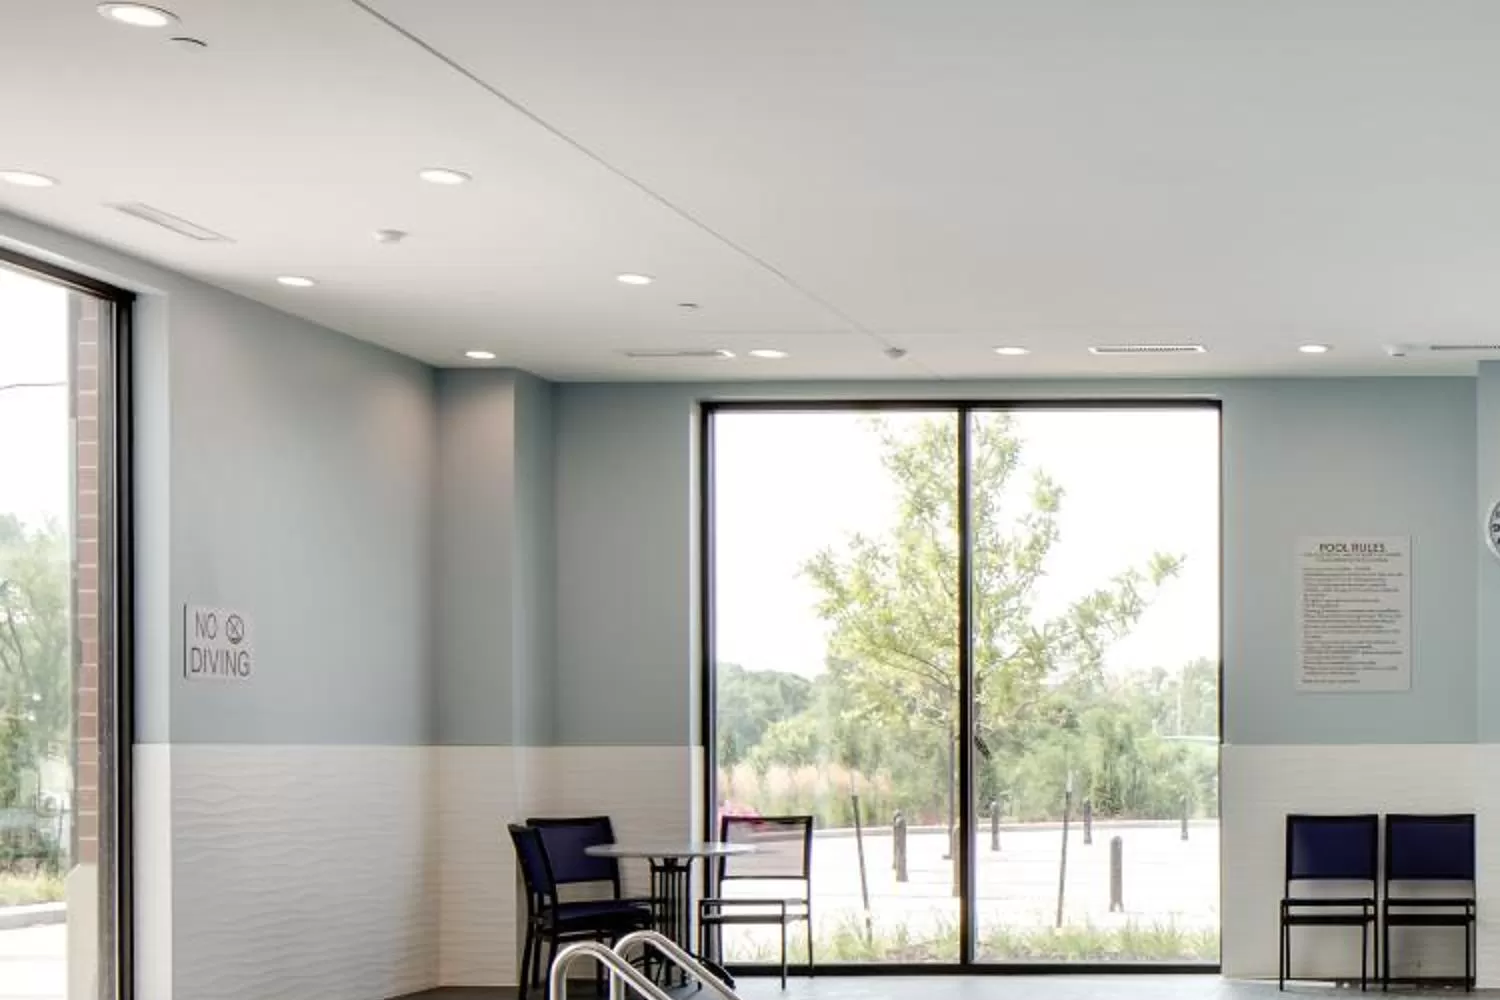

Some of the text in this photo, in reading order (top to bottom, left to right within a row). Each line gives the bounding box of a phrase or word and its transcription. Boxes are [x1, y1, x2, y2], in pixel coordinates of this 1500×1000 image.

[1319, 543, 1385, 553] POOL RULES
[195, 609, 217, 640] NO
[191, 646, 250, 677] DIVING
